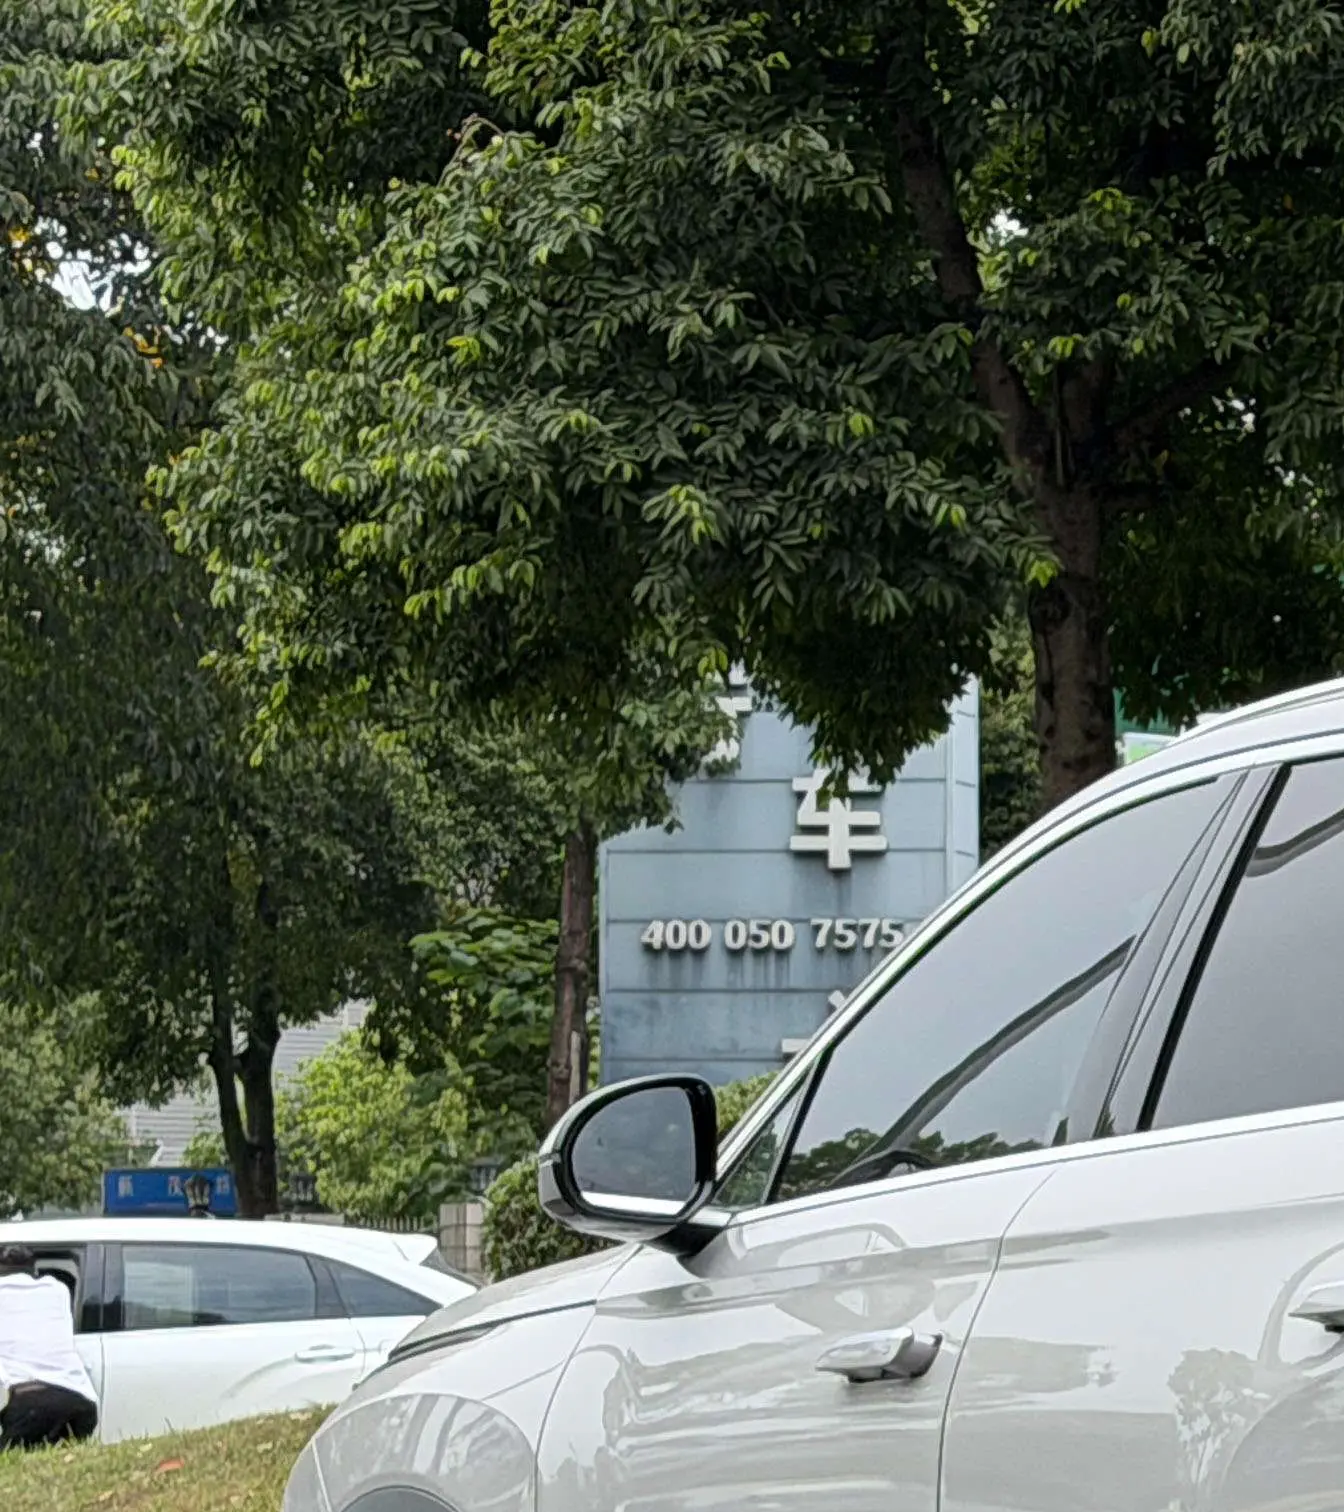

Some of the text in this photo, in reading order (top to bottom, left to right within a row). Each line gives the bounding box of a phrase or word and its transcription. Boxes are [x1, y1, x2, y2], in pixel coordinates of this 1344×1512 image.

[641, 917, 904, 950] 400 050 7575
